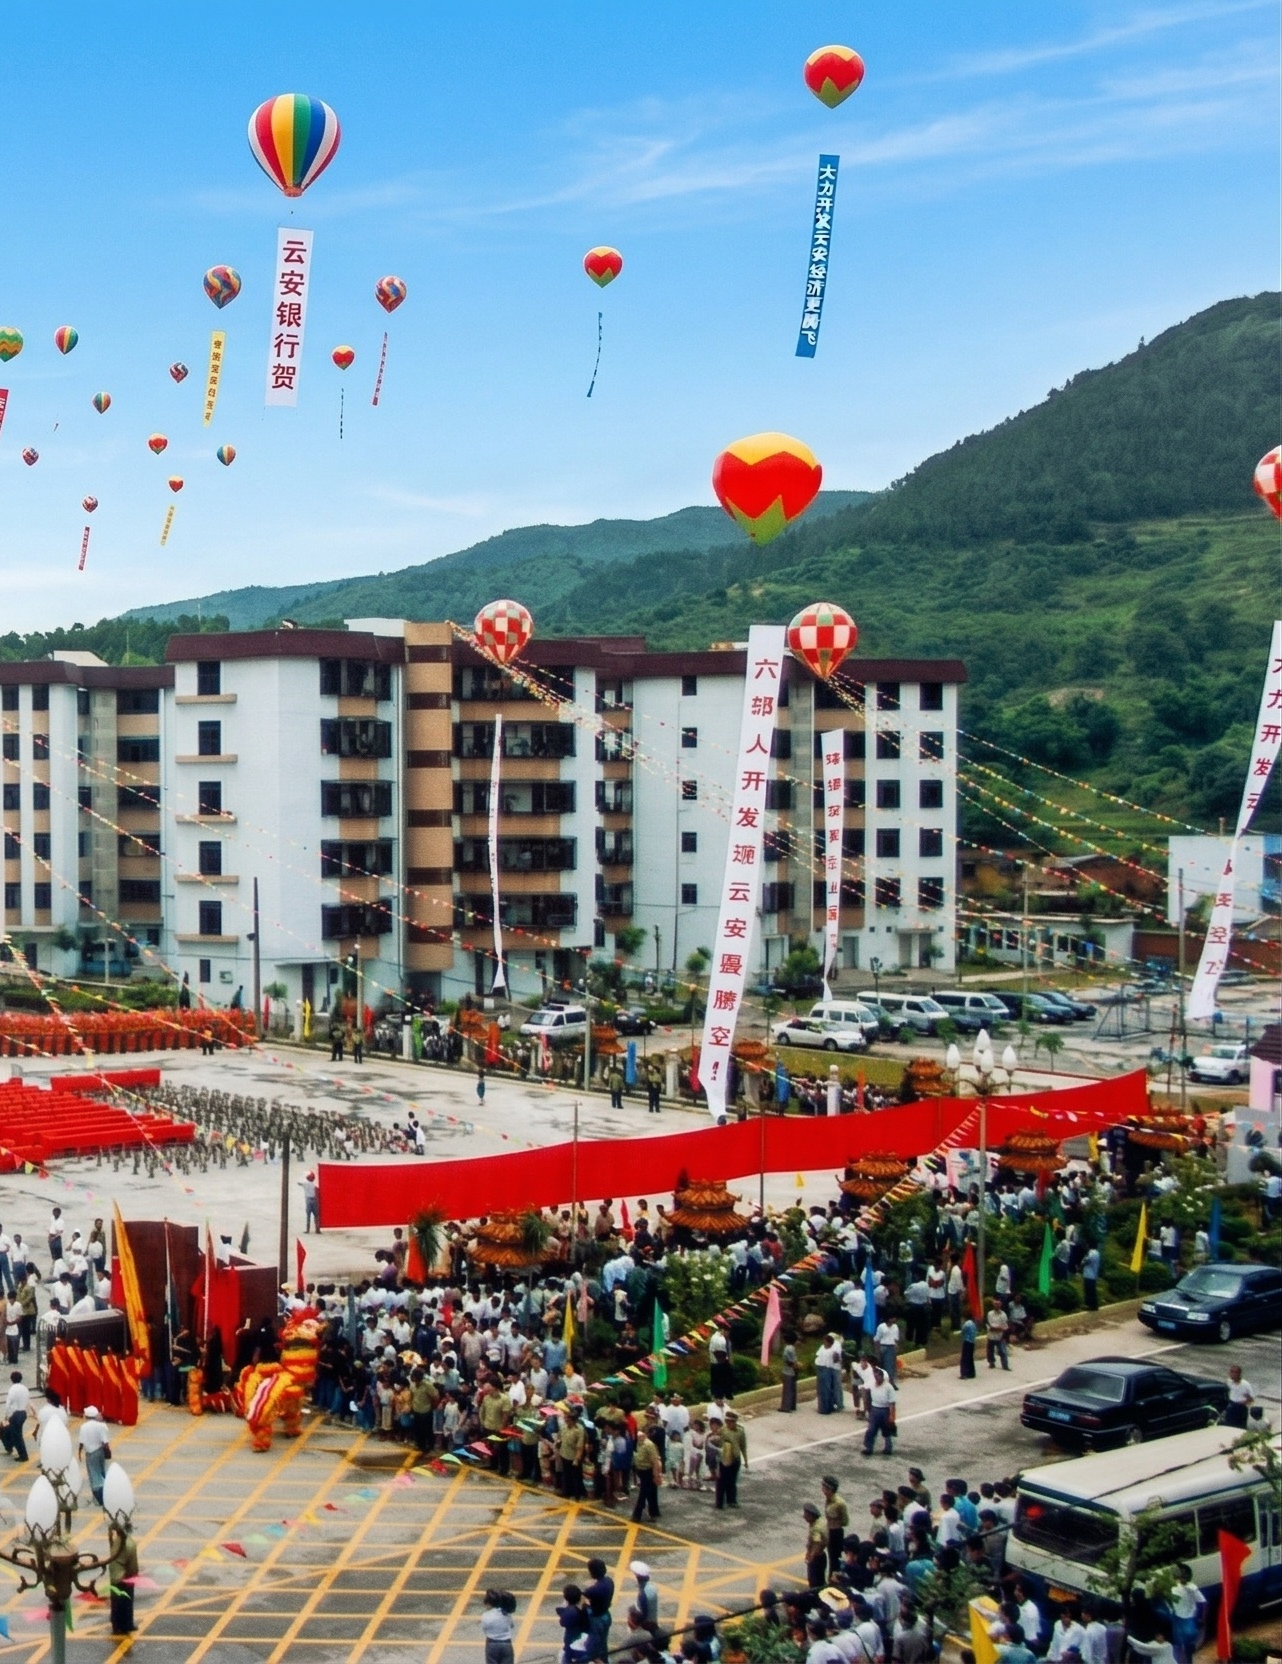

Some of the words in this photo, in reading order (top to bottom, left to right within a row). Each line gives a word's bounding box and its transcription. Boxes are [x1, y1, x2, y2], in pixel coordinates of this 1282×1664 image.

[272, 240, 307, 390] 云安银行贺
